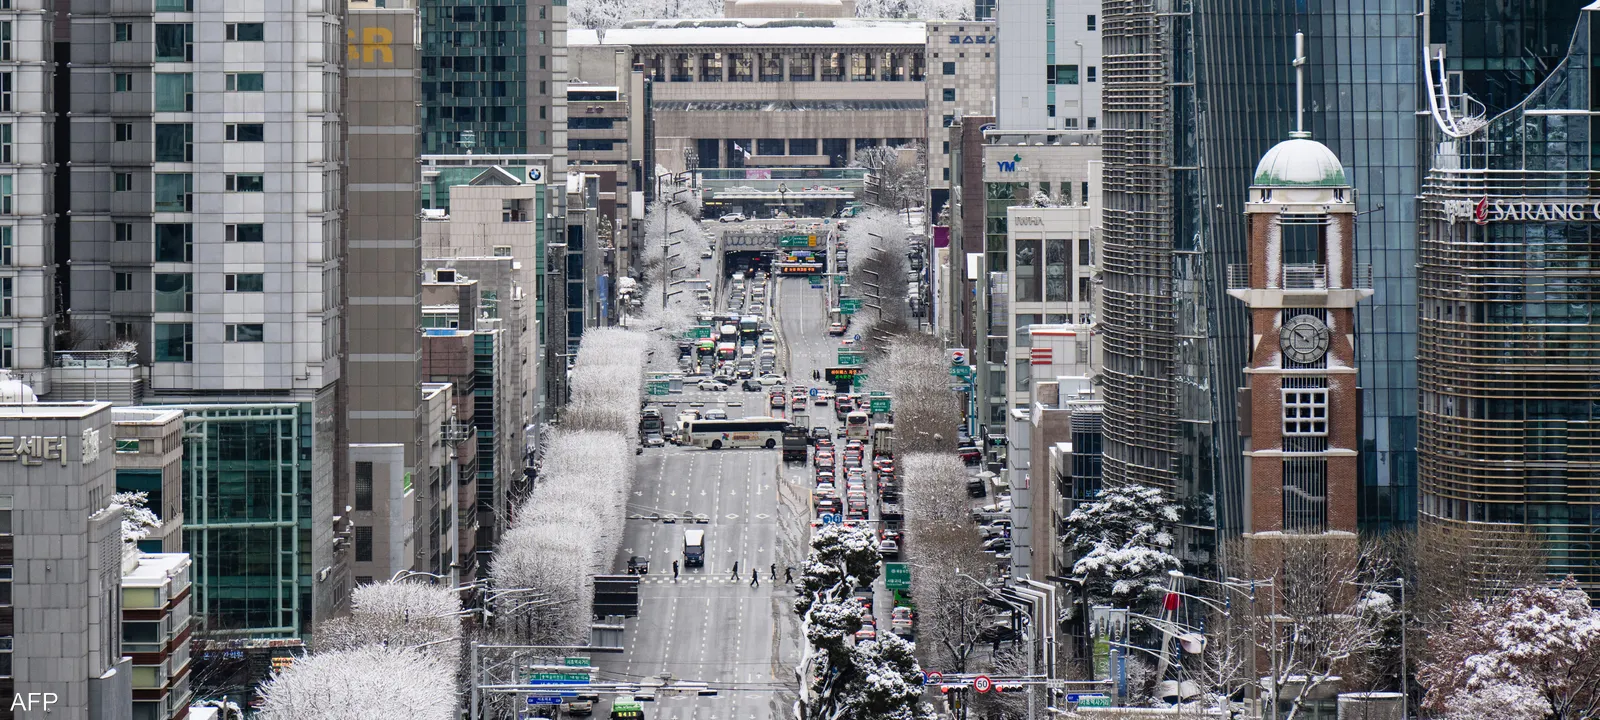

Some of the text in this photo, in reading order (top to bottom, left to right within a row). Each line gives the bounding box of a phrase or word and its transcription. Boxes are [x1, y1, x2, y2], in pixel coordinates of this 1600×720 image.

[1494, 199, 1584, 221] SARANG
[0, 436, 67, 467] 트센터
[976, 680, 988, 689] 50
